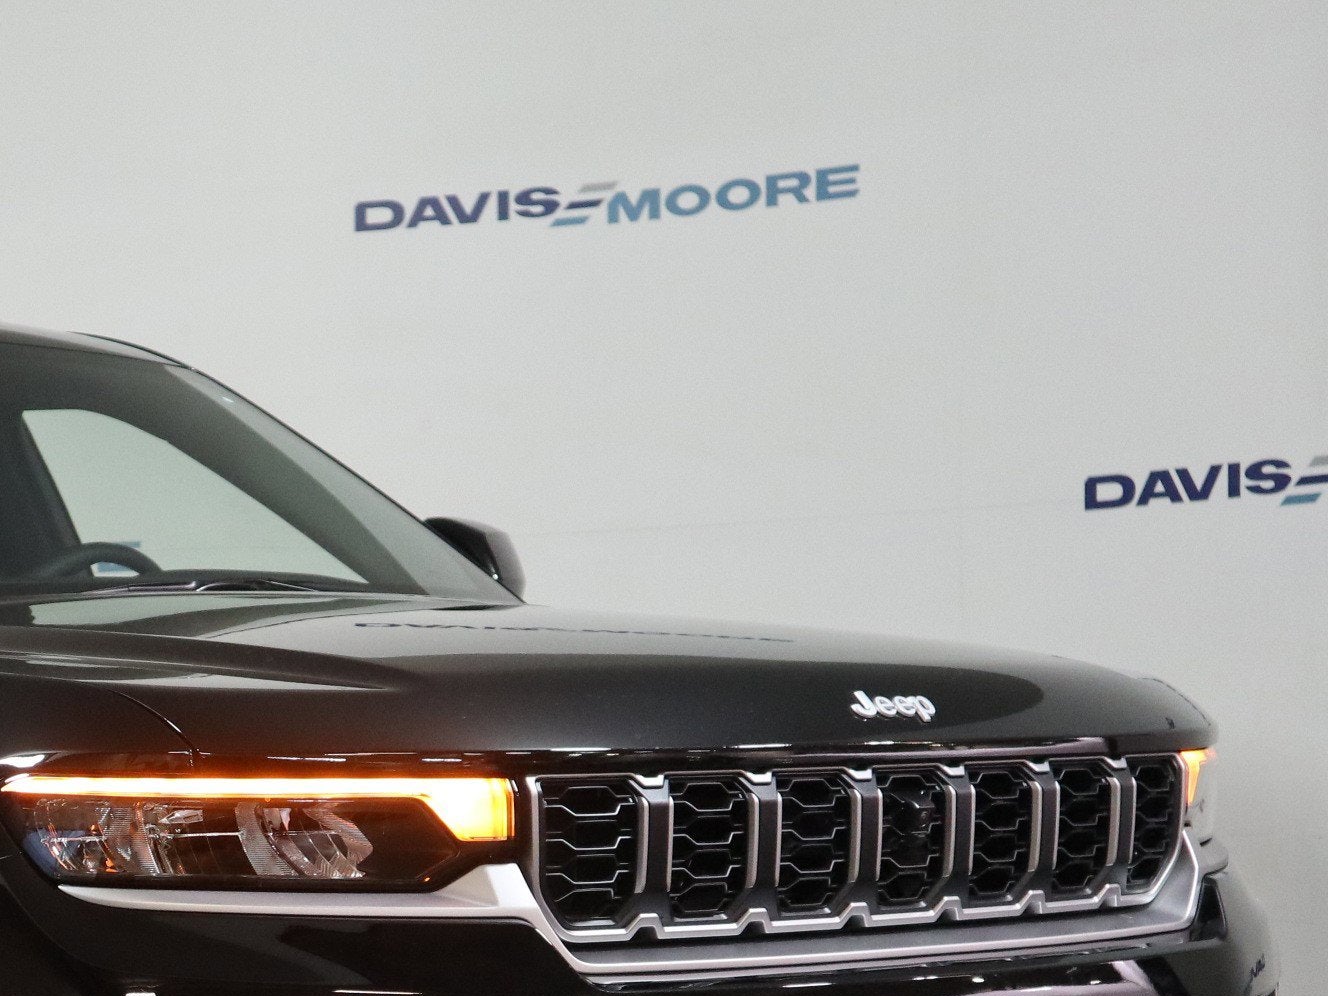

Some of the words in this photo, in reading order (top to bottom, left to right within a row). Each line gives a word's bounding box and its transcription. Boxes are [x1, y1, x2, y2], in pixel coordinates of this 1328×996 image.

[354, 185, 562, 232] DAVIS
[607, 164, 860, 224] MOORE
[1084, 458, 1292, 511] DAVIS
[850, 690, 936, 722] Jeep
